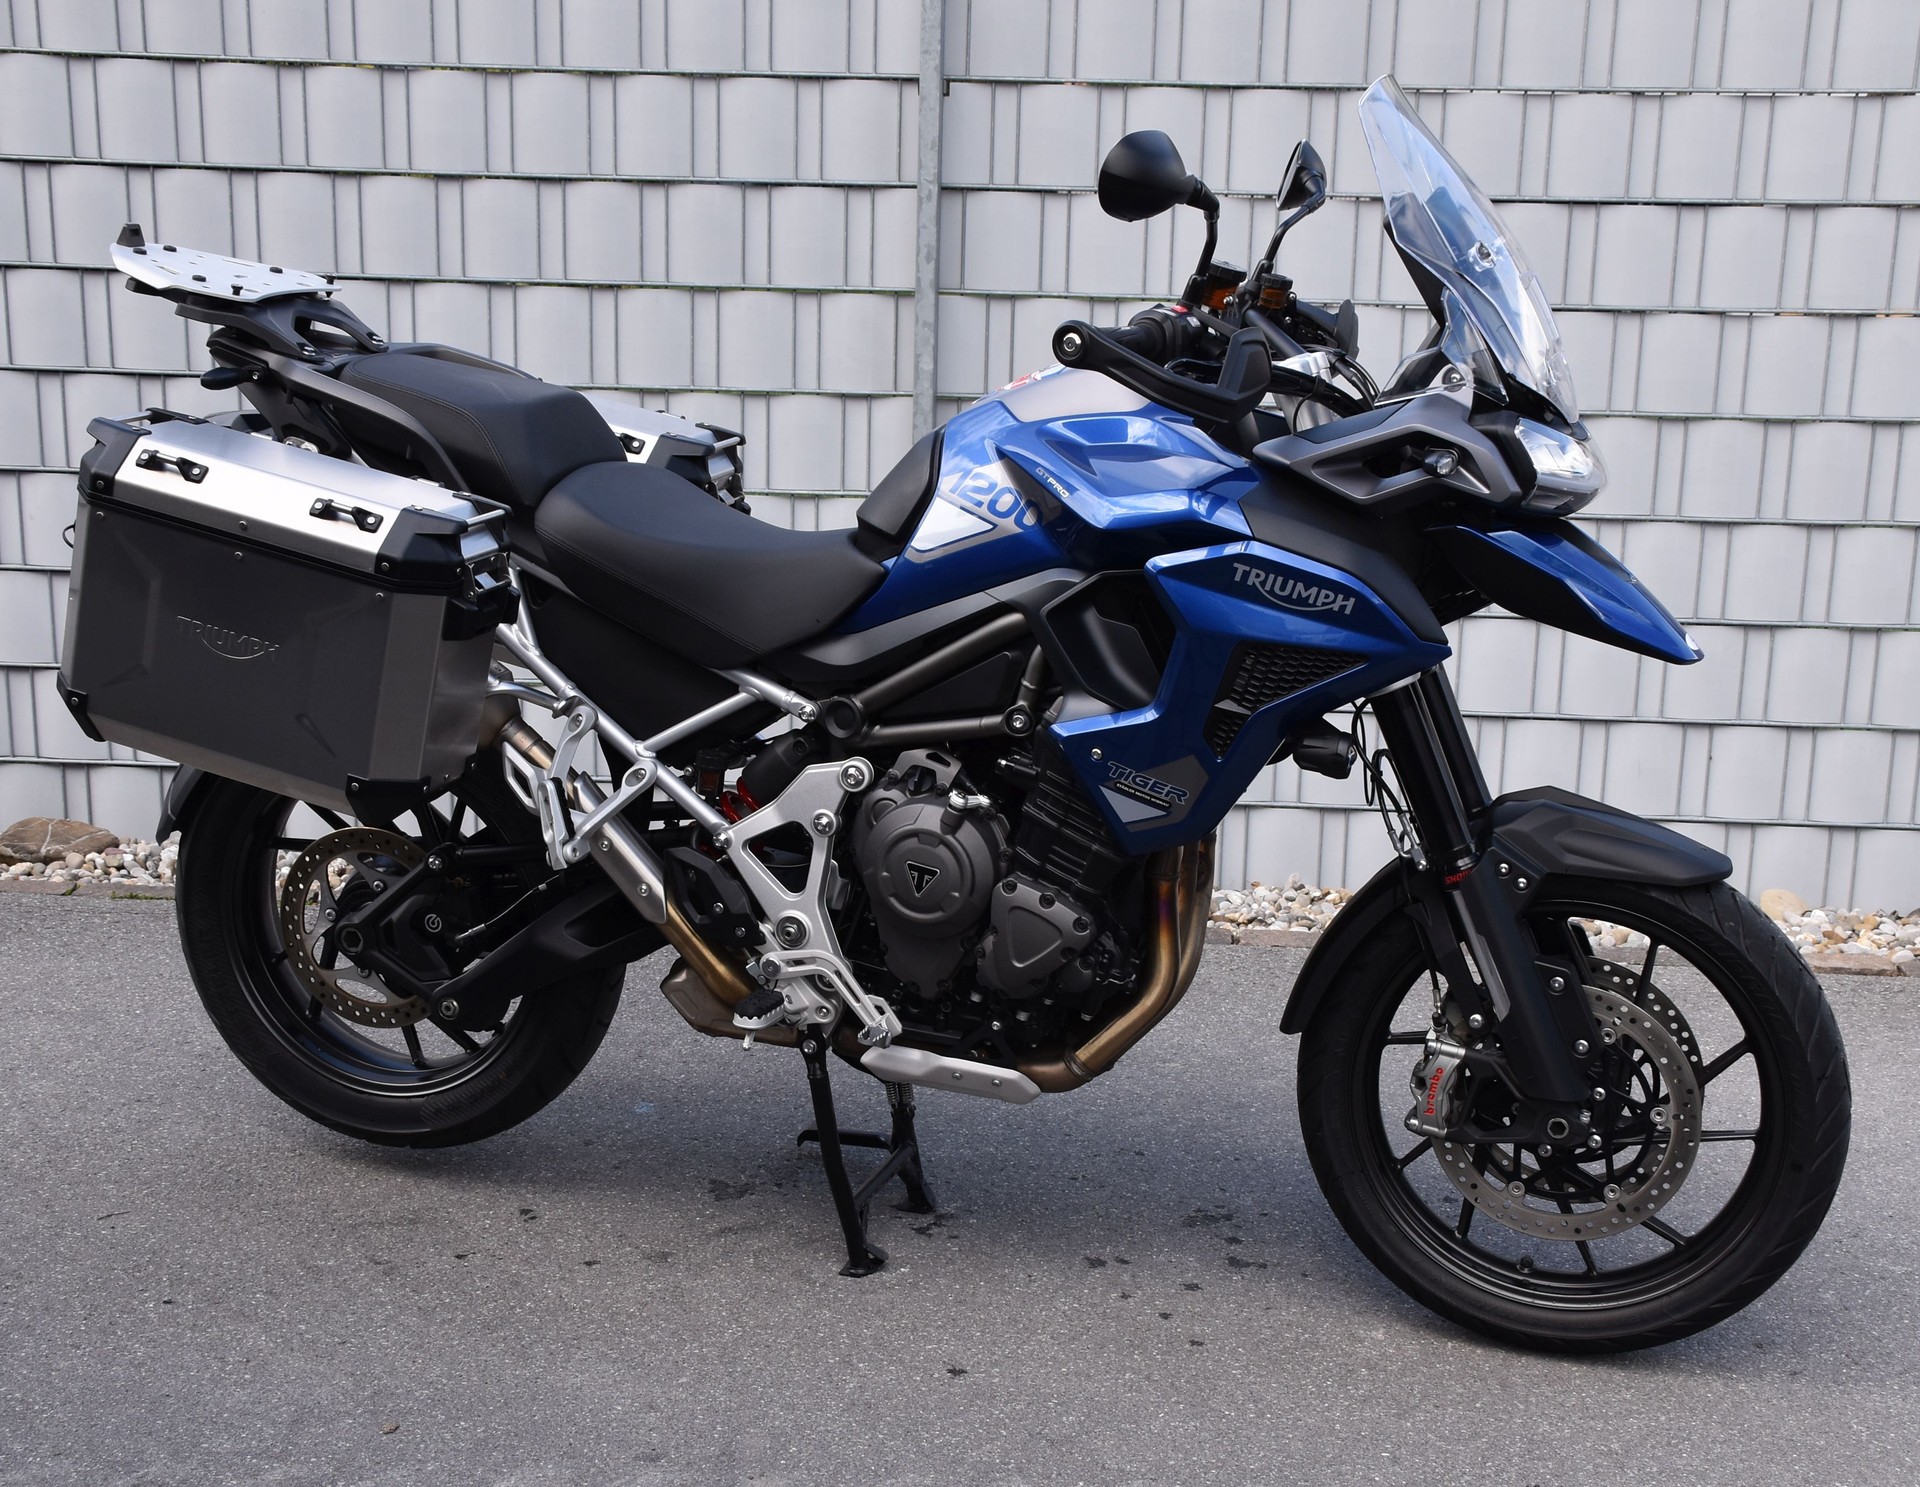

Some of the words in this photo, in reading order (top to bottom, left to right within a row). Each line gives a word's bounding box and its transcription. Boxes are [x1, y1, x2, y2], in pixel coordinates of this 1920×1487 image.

[947, 467, 1042, 531] 1200
[1232, 562, 1356, 615] TRIUMPH
[177, 615, 280, 662] TRIUMPH
[1107, 761, 1190, 805] TIGER
[1423, 1067, 1444, 1116] brembo
